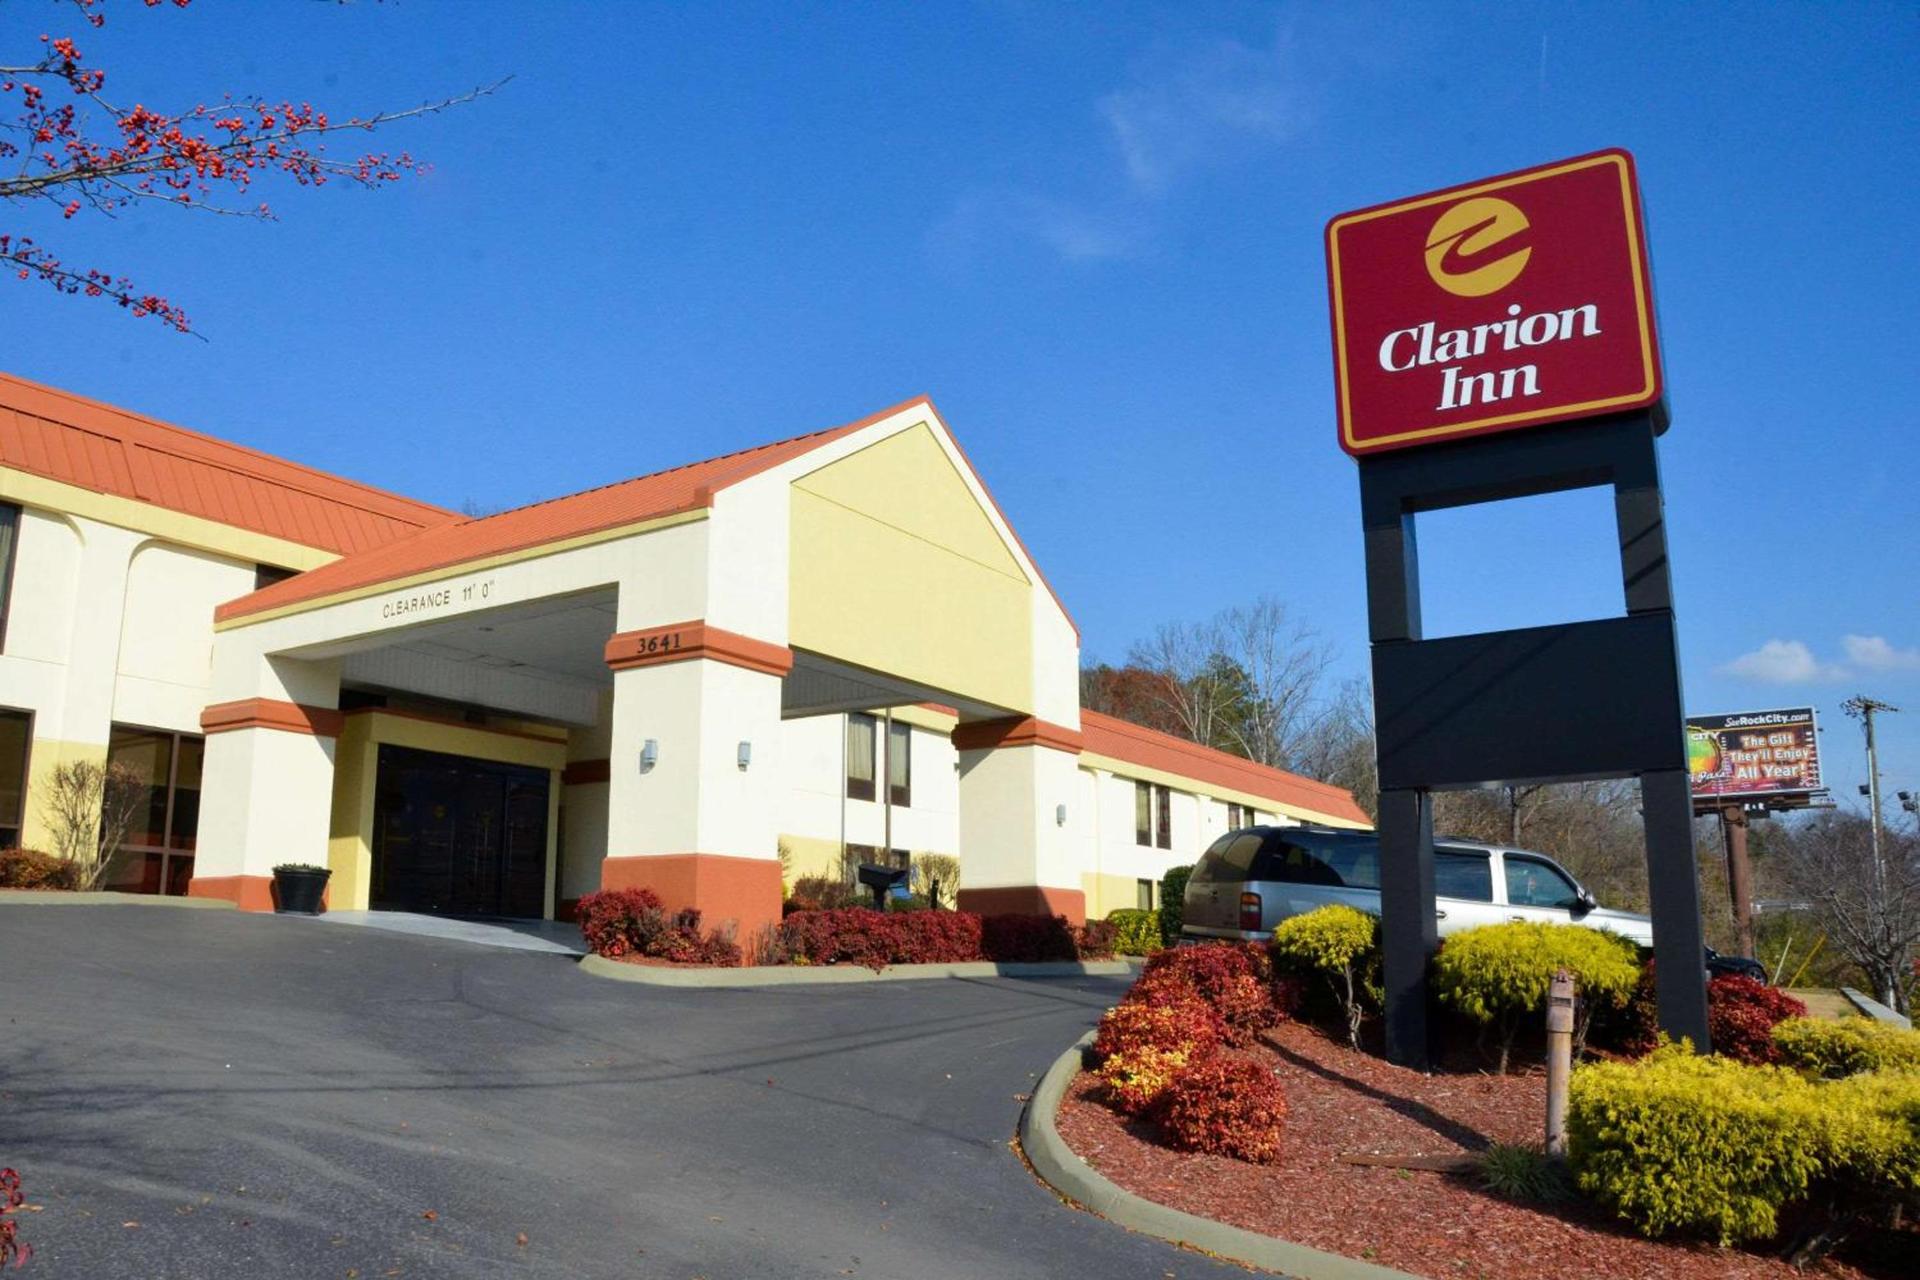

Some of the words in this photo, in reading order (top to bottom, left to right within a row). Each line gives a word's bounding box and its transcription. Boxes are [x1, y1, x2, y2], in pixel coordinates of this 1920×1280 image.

[1379, 304, 1601, 372] Clarion
[1436, 364, 1541, 411] Inn
[383, 590, 450, 618] CLEARANCE
[637, 633, 680, 655] 3641
[1742, 736, 1765, 747] The
[1769, 733, 1795, 745] Gift
[1731, 750, 1770, 763] They'll
[1775, 748, 1810, 762] Enjoy
[1737, 766, 1757, 779] All
[1764, 764, 1806, 778] Year!
